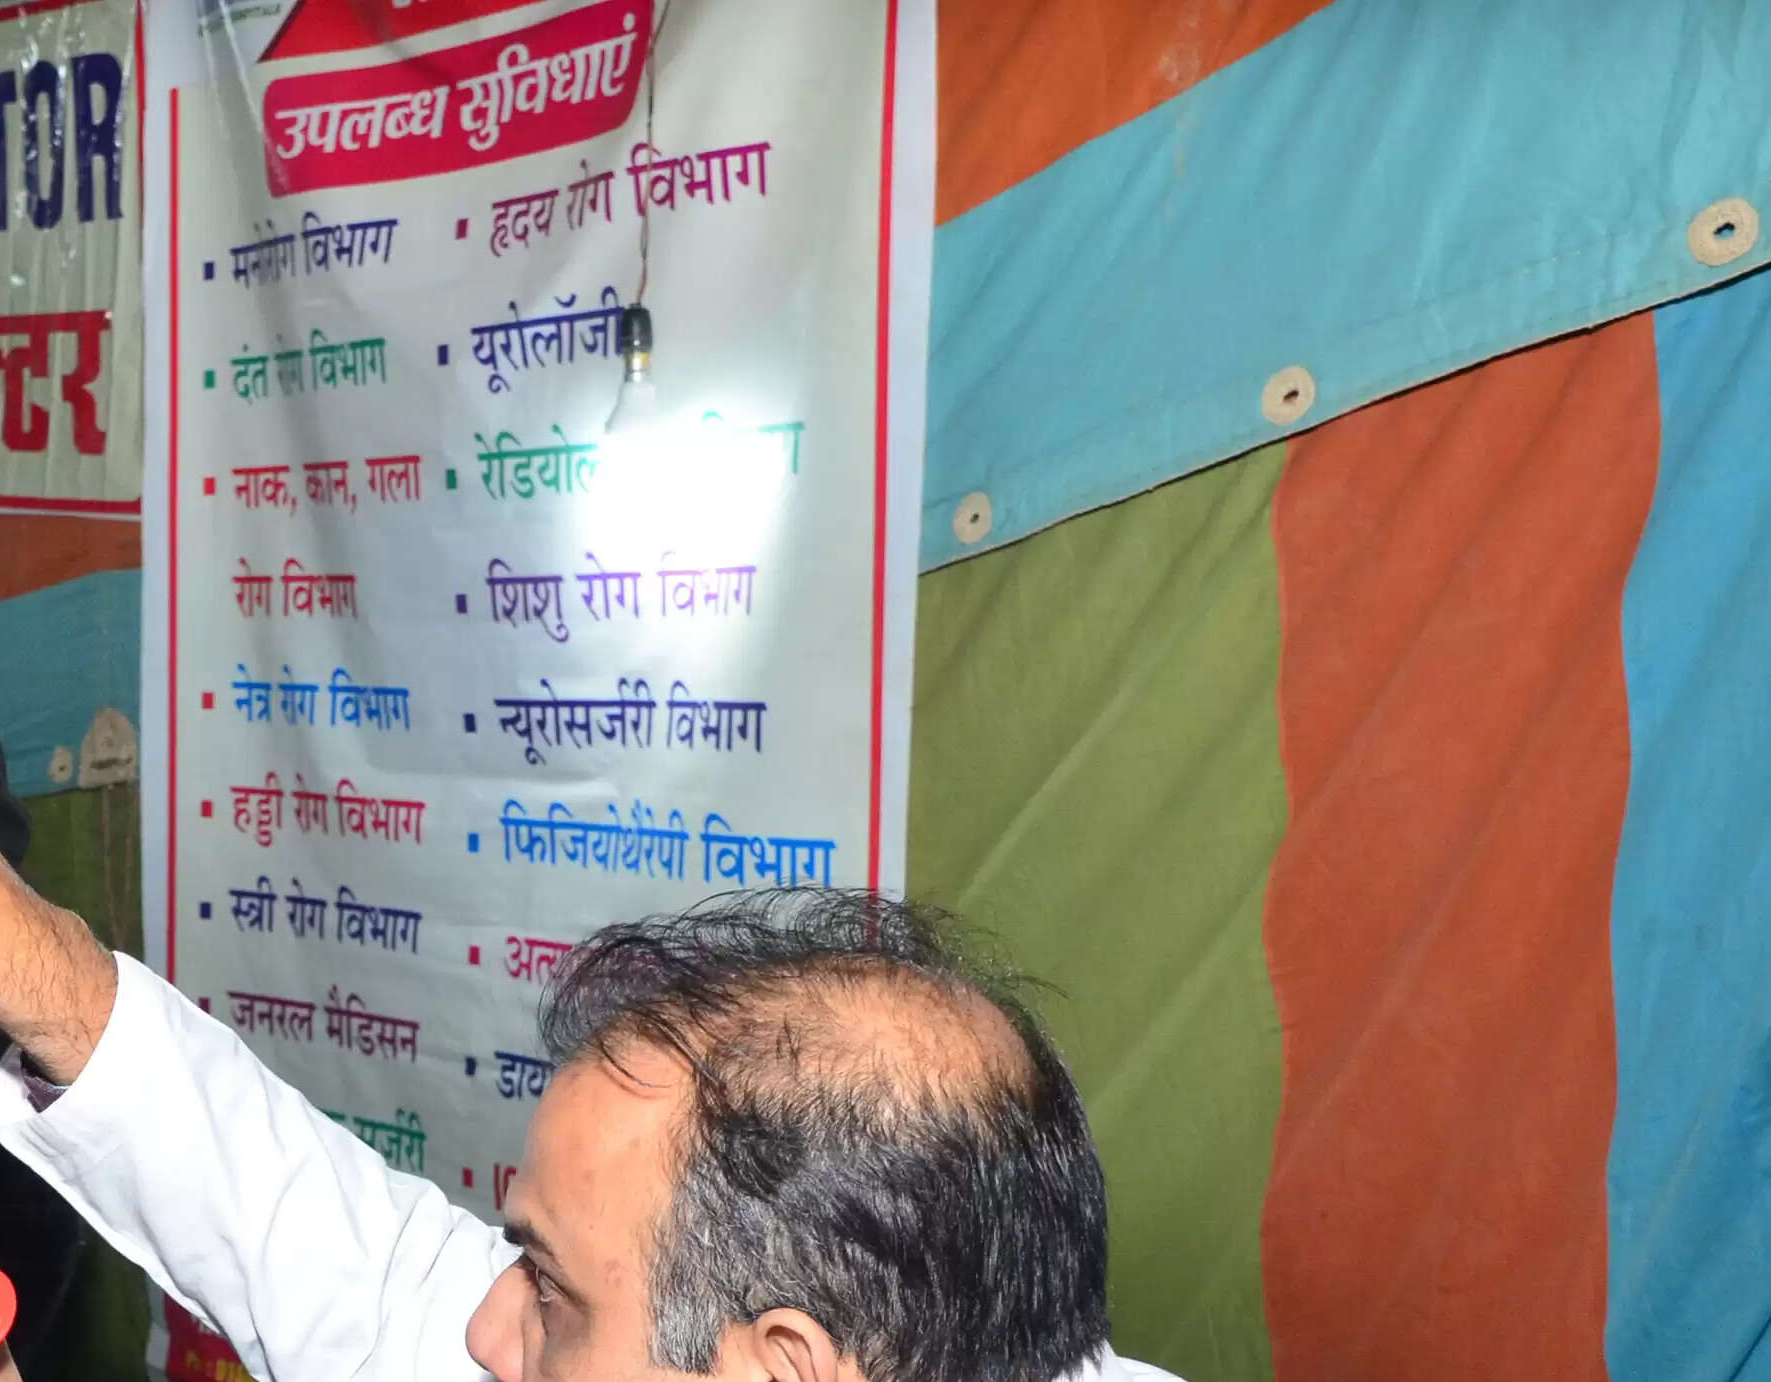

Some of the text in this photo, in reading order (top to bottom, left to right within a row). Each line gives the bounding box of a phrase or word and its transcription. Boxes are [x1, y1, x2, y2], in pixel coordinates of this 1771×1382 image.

[275, 13, 636, 158] उपलब्ध सुविधाएं
[490, 142, 771, 258] हृदय रोग विभाग
[301, 211, 399, 276] विभाग
[231, 343, 269, 404] दंत
[308, 328, 386, 392] विभाग
[471, 286, 626, 394] यूरोलॉजी
[232, 465, 300, 518] नाक,
[365, 455, 421, 504] गला
[232, 557, 358, 619] रोग विभाग
[485, 551, 757, 643] शिशु रोग विभाग
[232, 663, 410, 730] नेत्र रोग विभाग
[494, 678, 767, 766] न्यूरोसर्जरी विभाग
[230, 771, 426, 848] हड्डी रोग विभाग
[701, 813, 836, 887] विभाग
[229, 876, 422, 955] स्त्री रोग विभाग
[227, 984, 420, 1064] जनरल मैडिसन
